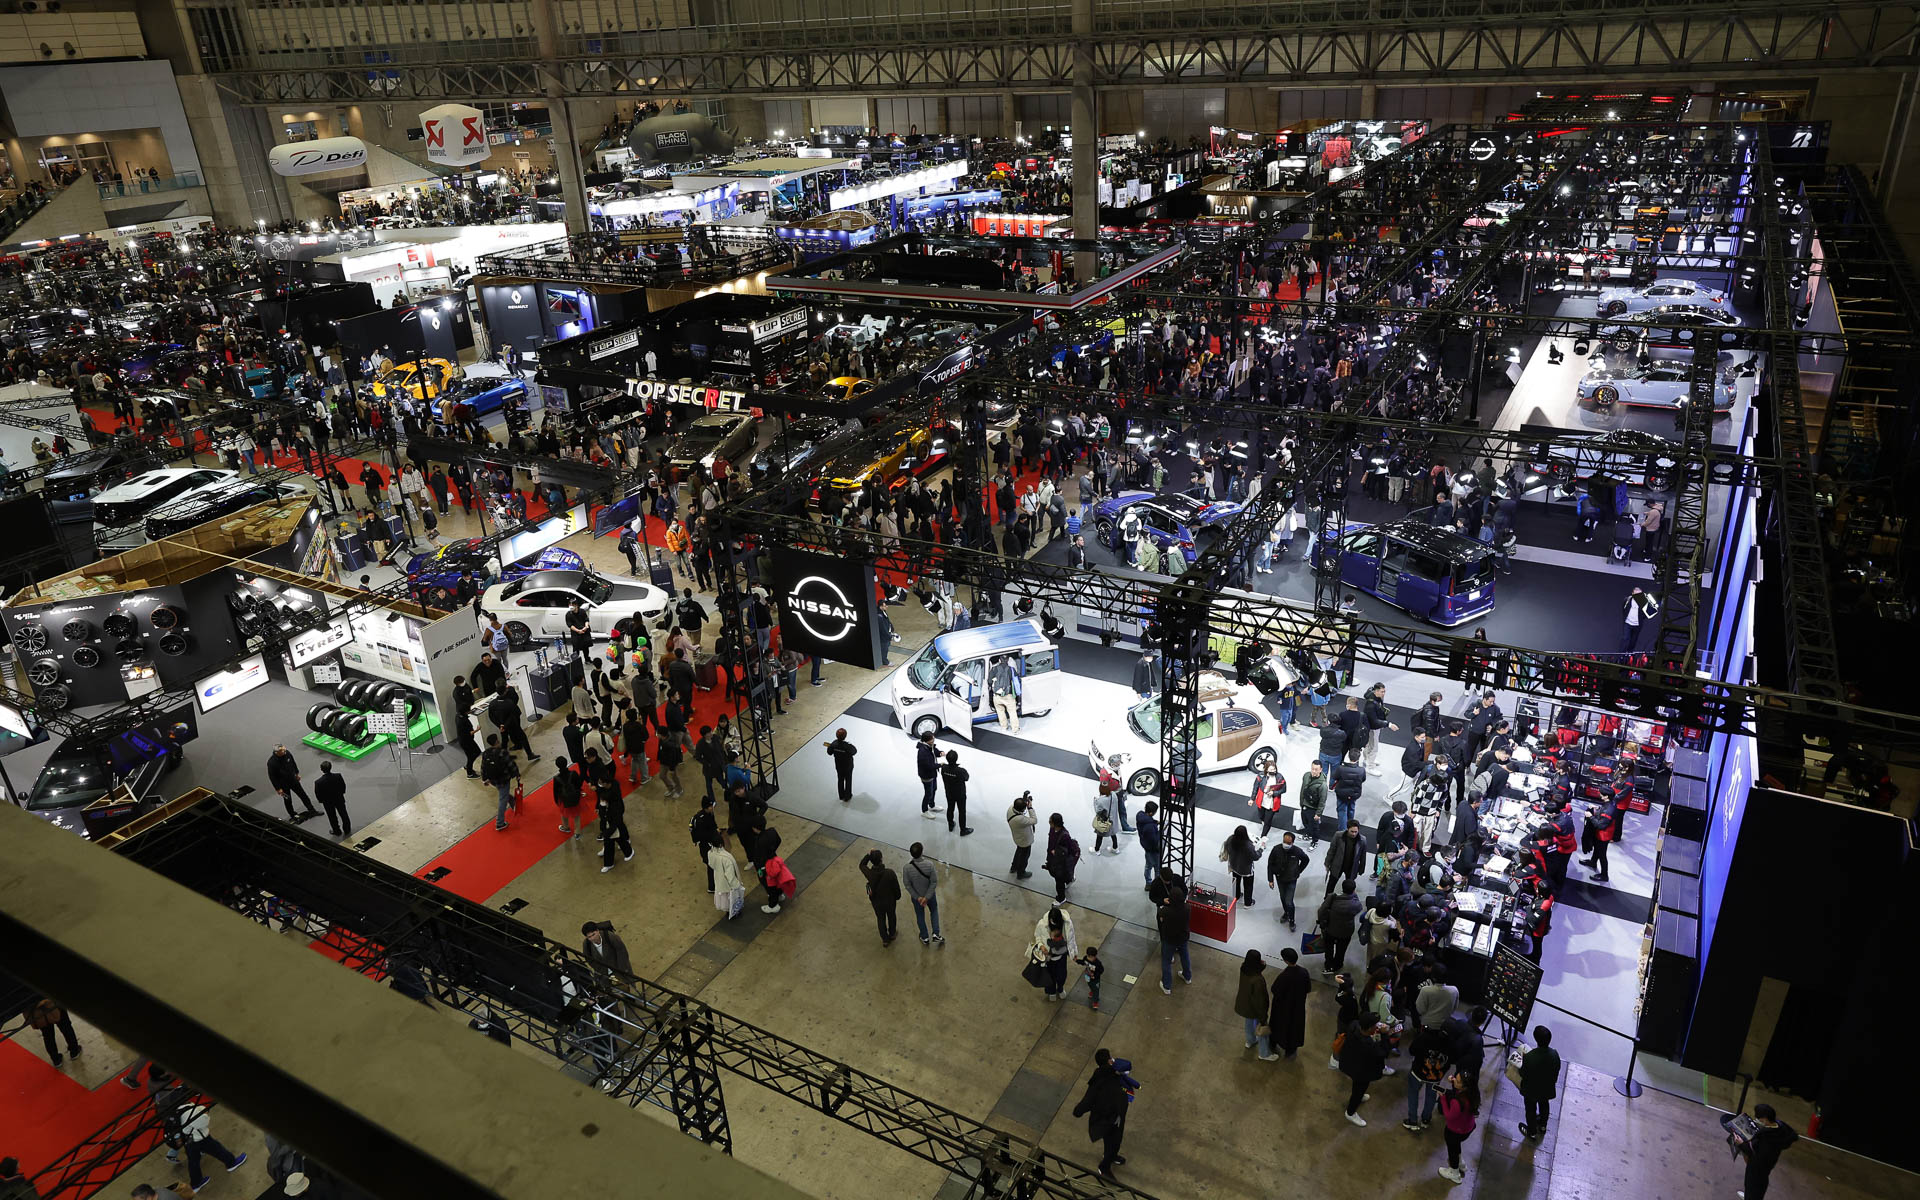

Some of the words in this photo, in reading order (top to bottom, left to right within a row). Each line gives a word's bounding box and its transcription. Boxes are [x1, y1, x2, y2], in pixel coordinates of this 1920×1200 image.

[657, 131, 685, 141] BLACK
[657, 137, 687, 147] RHINO
[1214, 204, 1249, 216] DEAN
[756, 320, 778, 336] TOP
[780, 308, 806, 327] SECRET
[591, 339, 614, 354] TOP
[614, 333, 637, 347] SECRET
[937, 367, 951, 384] TOP
[950, 356, 973, 378] SECRET
[625, 377, 667, 401] TOP
[667, 383, 747, 412] SECRET
[787, 596, 858, 622] NISSAN
[297, 630, 344, 657] TYRES
[443, 643, 456, 654] ABE
[454, 633, 477, 650] SHOKAI
